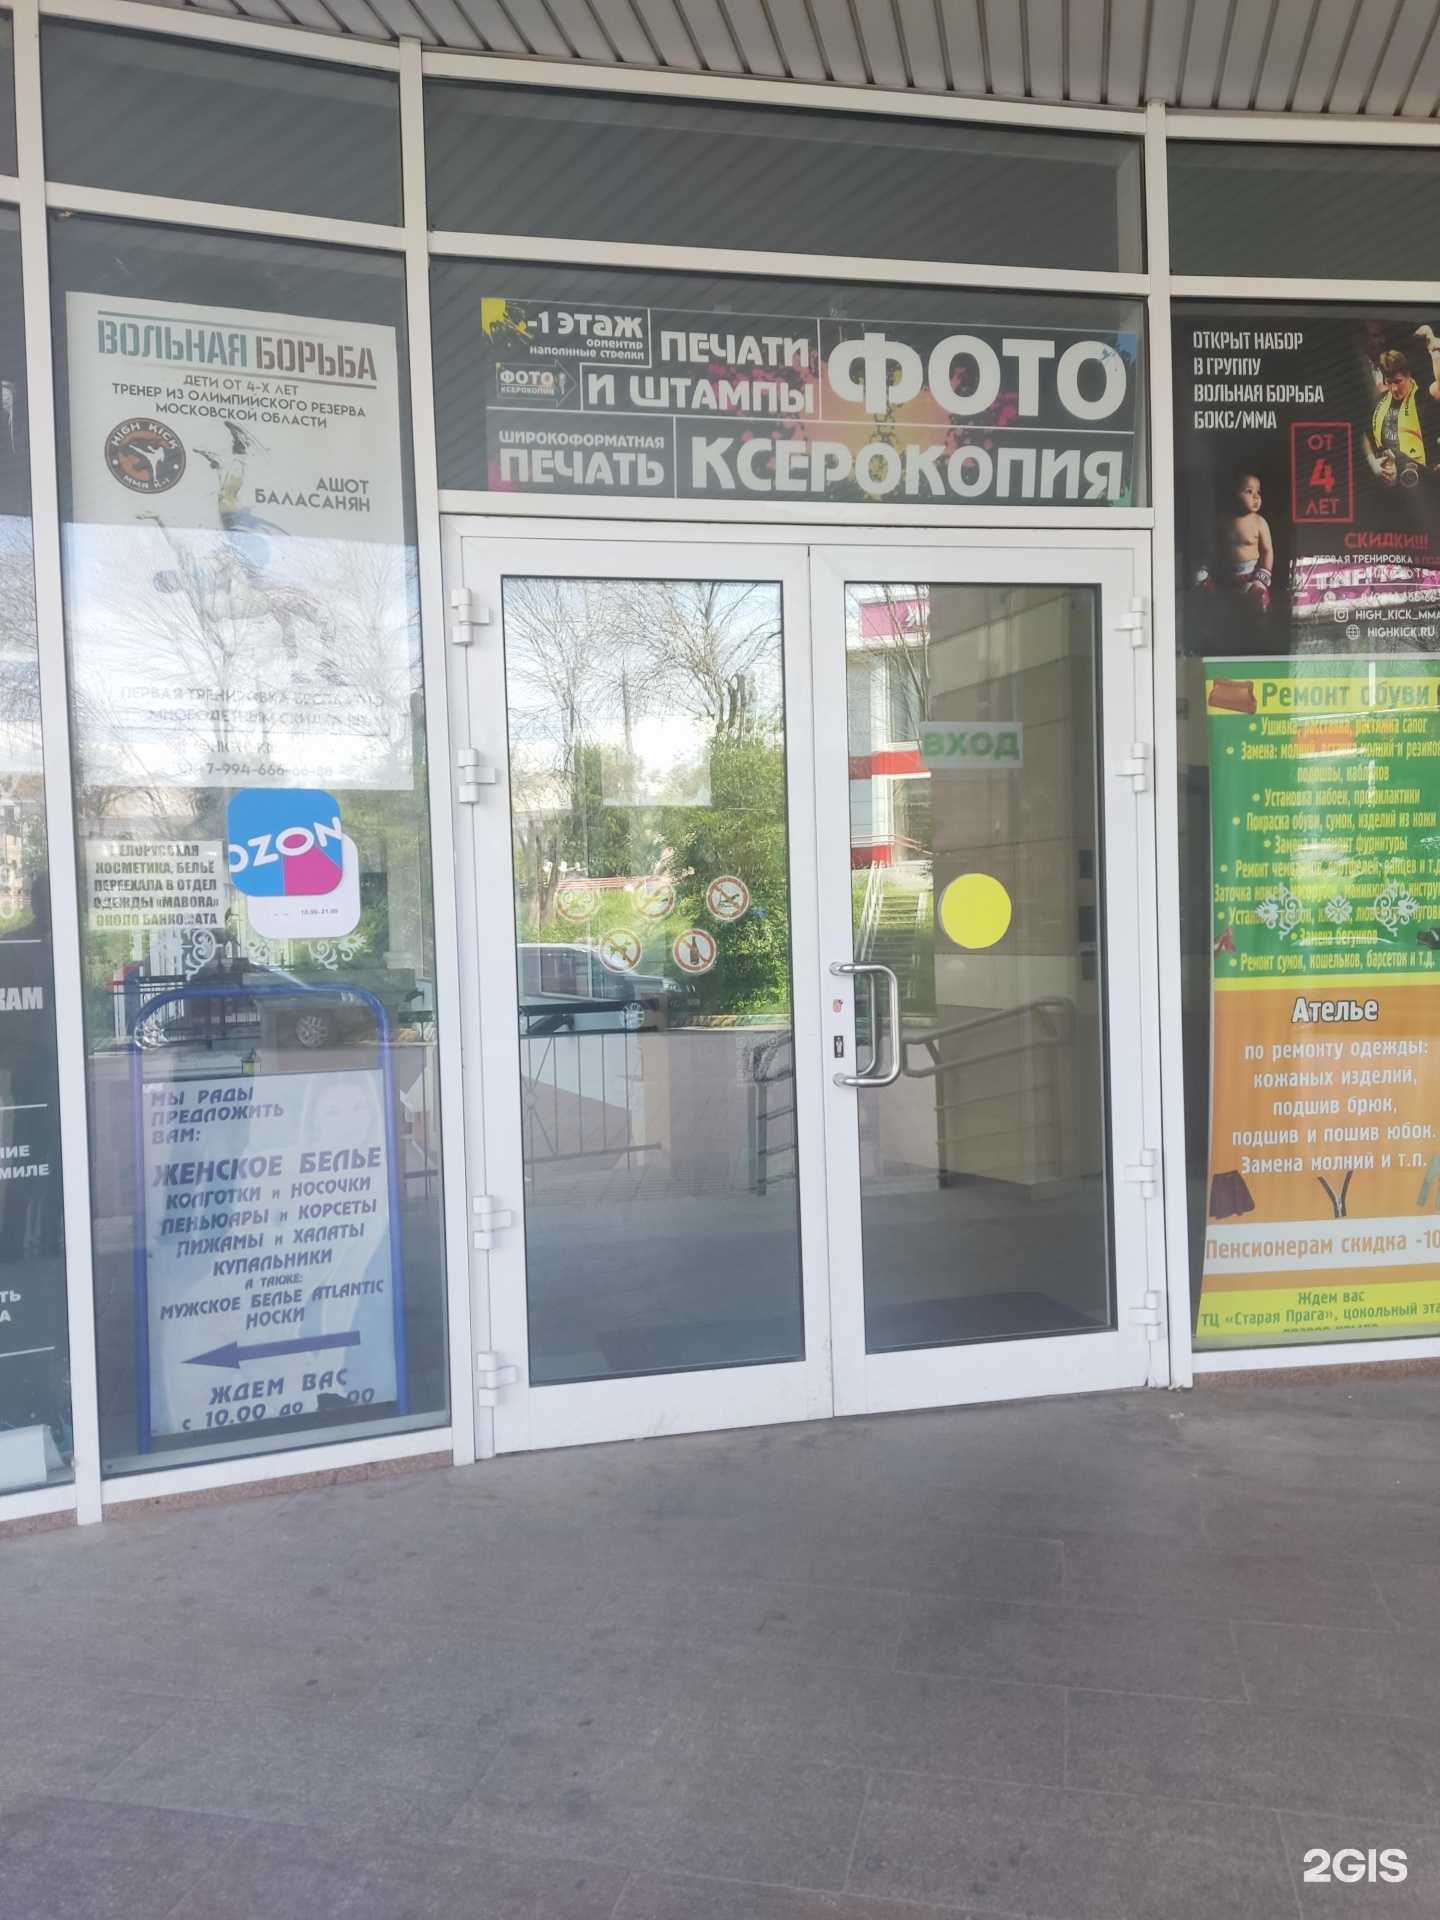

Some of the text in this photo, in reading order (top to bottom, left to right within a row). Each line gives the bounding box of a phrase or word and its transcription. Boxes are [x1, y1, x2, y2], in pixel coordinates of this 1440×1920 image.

[527, 310, 550, 334] -1
[97, 319, 377, 381] ВОЛЬНАЯ БОРЬБА
[586, 338, 643, 350] ориентир
[660, 330, 809, 367] ПЕЧАТИ
[1193, 331, 1303, 350] ОТКРЫТ НАБОР
[600, 349, 644, 360] стрелки
[500, 370, 553, 384] ФОТО
[827, 332, 1126, 420] ФОТО
[1193, 357, 1261, 377] В ГРУППУ
[183, 374, 219, 389] ДЕТИ
[223, 378, 243, 390] ОТ
[274, 384, 298, 397] ЛЕТ
[588, 374, 813, 413] И ШТАМПЫ
[1194, 384, 1324, 403] ВОЛЬНАЯ БОРЬБА
[112, 382, 366, 417] ТРЕНЕР ИЗ ОЛИМПИЙСКОГО РЕЗЕРВА
[156, 401, 327, 428] МОСКОВСКОЙ ОБЛАСТИ
[1194, 410, 1277, 429] БОКС/ММА
[111, 422, 178, 449] HIGH KICK
[499, 430, 664, 448] ШИРОКОФОРМАТНАЯ
[1307, 433, 1332, 451] ОТ
[500, 448, 664, 486] ПЕЧАТЬ
[692, 436, 1122, 500] КСЕРОКОПИЯ
[1310, 458, 1335, 492] 4
[316, 477, 369, 494] АШОТ
[255, 488, 370, 512] БАЛАСАНЯН
[1305, 498, 1340, 515] ЛЕТ
[1343, 532, 1429, 549] СКИДКИ!!!
[1352, 554, 1413, 564] ТРЕНИРОВКА
[1367, 626, 1435, 637] HIGHKICK.RU
[1262, 680, 1429, 707] Ремонт обуви
[1403, 717, 1427, 733] сапог
[1241, 741, 1277, 760] Замена:
[1347, 764, 1389, 782] каблков
[1264, 789, 1312, 807] Установка
[1246, 812, 1289, 831] Покраска
[110, 845, 199, 857] ЕЛОРУССКАЯ
[228, 816, 343, 873] OZON
[1235, 859, 1269, 879] Ремонт
[94, 879, 163, 892] ПЕРЕЕХАЛА
[177, 879, 217, 892] ОТДЕЛ
[94, 896, 153, 909] ОДЕЖДЫ
[96, 914, 139, 926] ОКОЛО
[1241, 953, 1274, 972] Ремонт
[1291, 997, 1379, 1023] Ателье
[1245, 1039, 1429, 1062] по ремонту одежды:
[1254, 1065, 1418, 1088] кожаных изделий,
[151, 1087, 253, 1107] МЫ РАДЫ
[1273, 1095, 1398, 1118] подшив брюк,
[151, 1103, 284, 1126] ПРЕДЛОЖИТЬ
[151, 1128, 200, 1145] ВАМ:
[1232, 1121, 1437, 1148] подшив и пошив юбок.
[152, 1147, 381, 1188] ЖЕНСКОЕ БЕЛЬЕ
[1241, 1151, 1428, 1174] Замена молний и т.п.
[166, 1187, 261, 1210] КОЛГОТКИ
[291, 1177, 371, 1199] НОСОЧКИ
[161, 1209, 268, 1236] ПЕНЬЮАРЫ
[299, 1200, 376, 1220] КОРСЕТЫ
[177, 1233, 263, 1258] ПИЖАМЫ
[293, 1223, 364, 1243] ХАЛАТЫ
[1206, 1237, 1333, 1260] Пенсионерам
[1341, 1233, 1407, 1255] скидка
[213, 1249, 332, 1276] КУПАЛЬНИКИ
[245, 1279, 253, 1290] А
[160, 1280, 384, 1320] МУЖСКОЕ БЕЛЬЕ ATLANTIC
[1298, 1290, 1365, 1306] Ждем вас
[246, 1307, 305, 1330] НОСКИ
[1201, 1312, 1219, 1328] ТЦ
[1225, 1309, 1280, 1326] «Старая
[1286, 1308, 1338, 1325] Прага»,
[1343, 1301, 1418, 1320] цокольный
[208, 1368, 348, 1405] ЖДЕМ ВАС
[205, 1403, 266, 1427] 10.00
